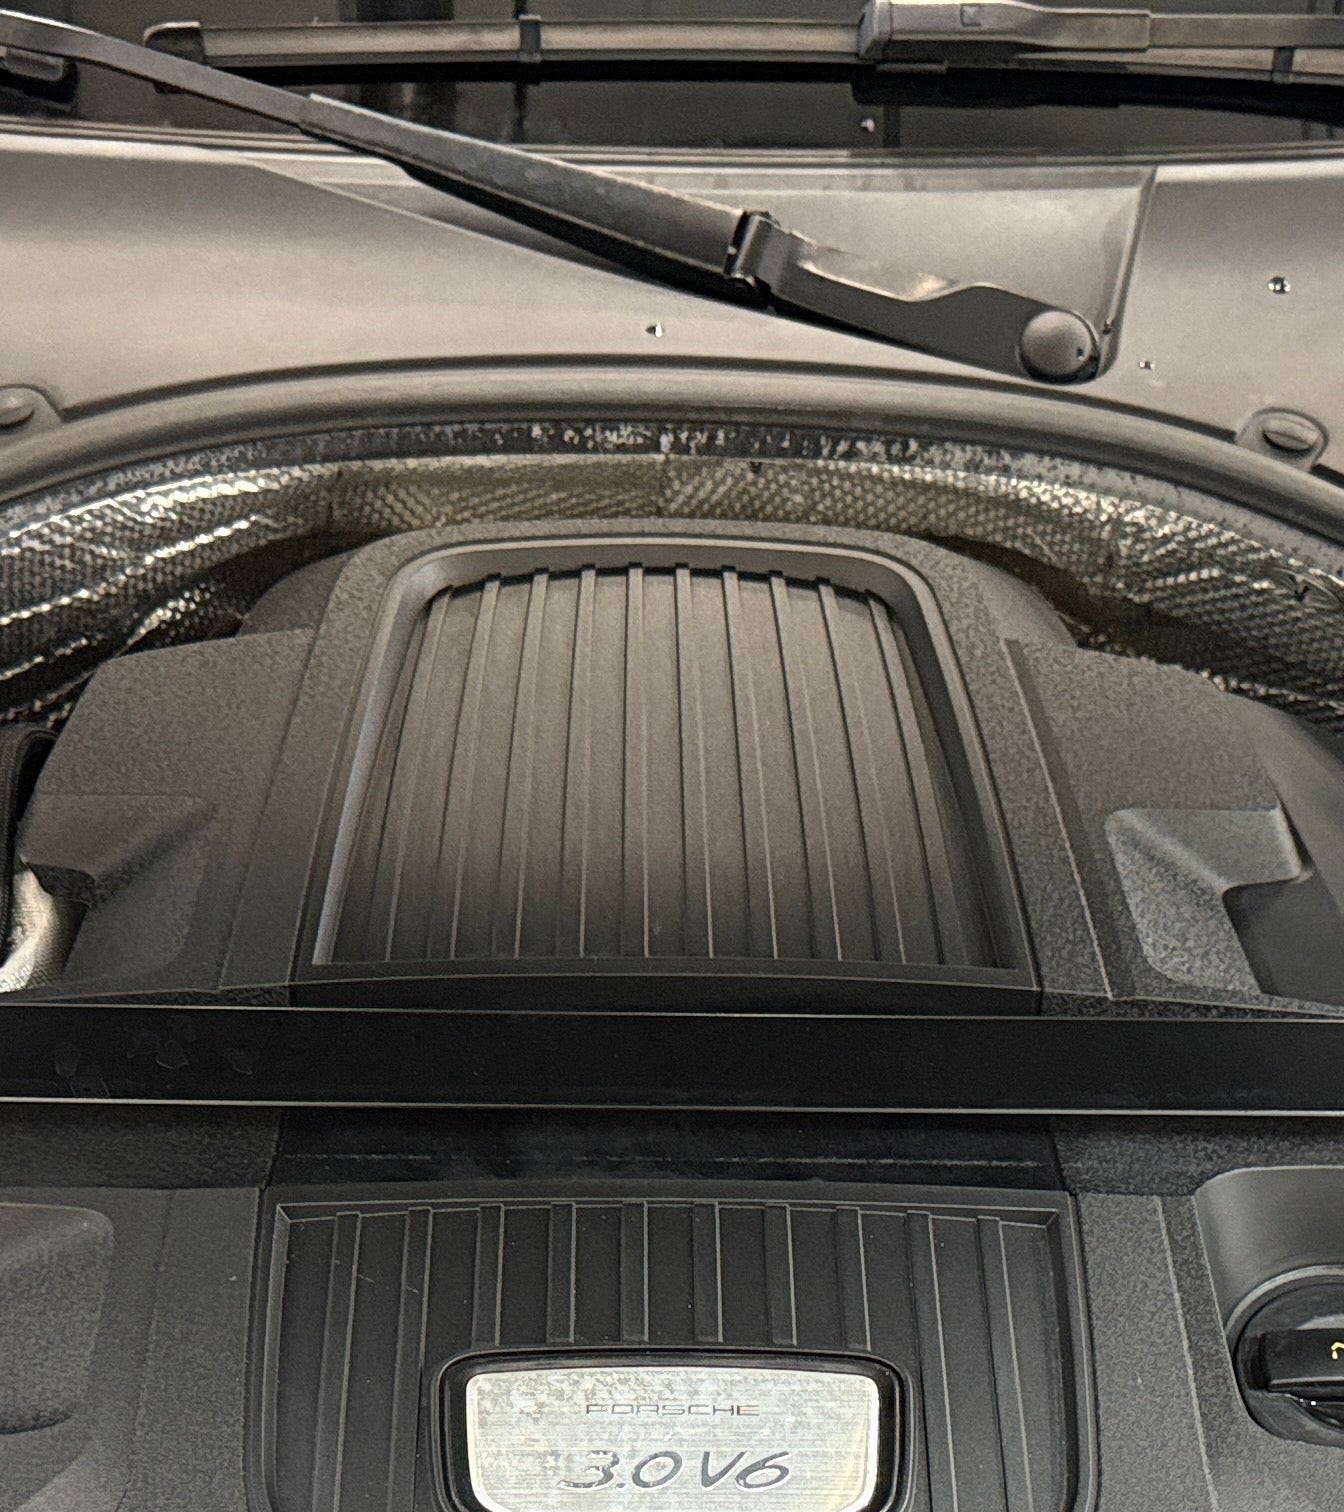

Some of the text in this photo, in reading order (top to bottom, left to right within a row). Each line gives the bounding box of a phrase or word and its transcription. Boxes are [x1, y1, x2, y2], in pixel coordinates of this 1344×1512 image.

[586, 1403, 761, 1417] PORSCHE
[558, 1450, 792, 1490] 3.0 V6
